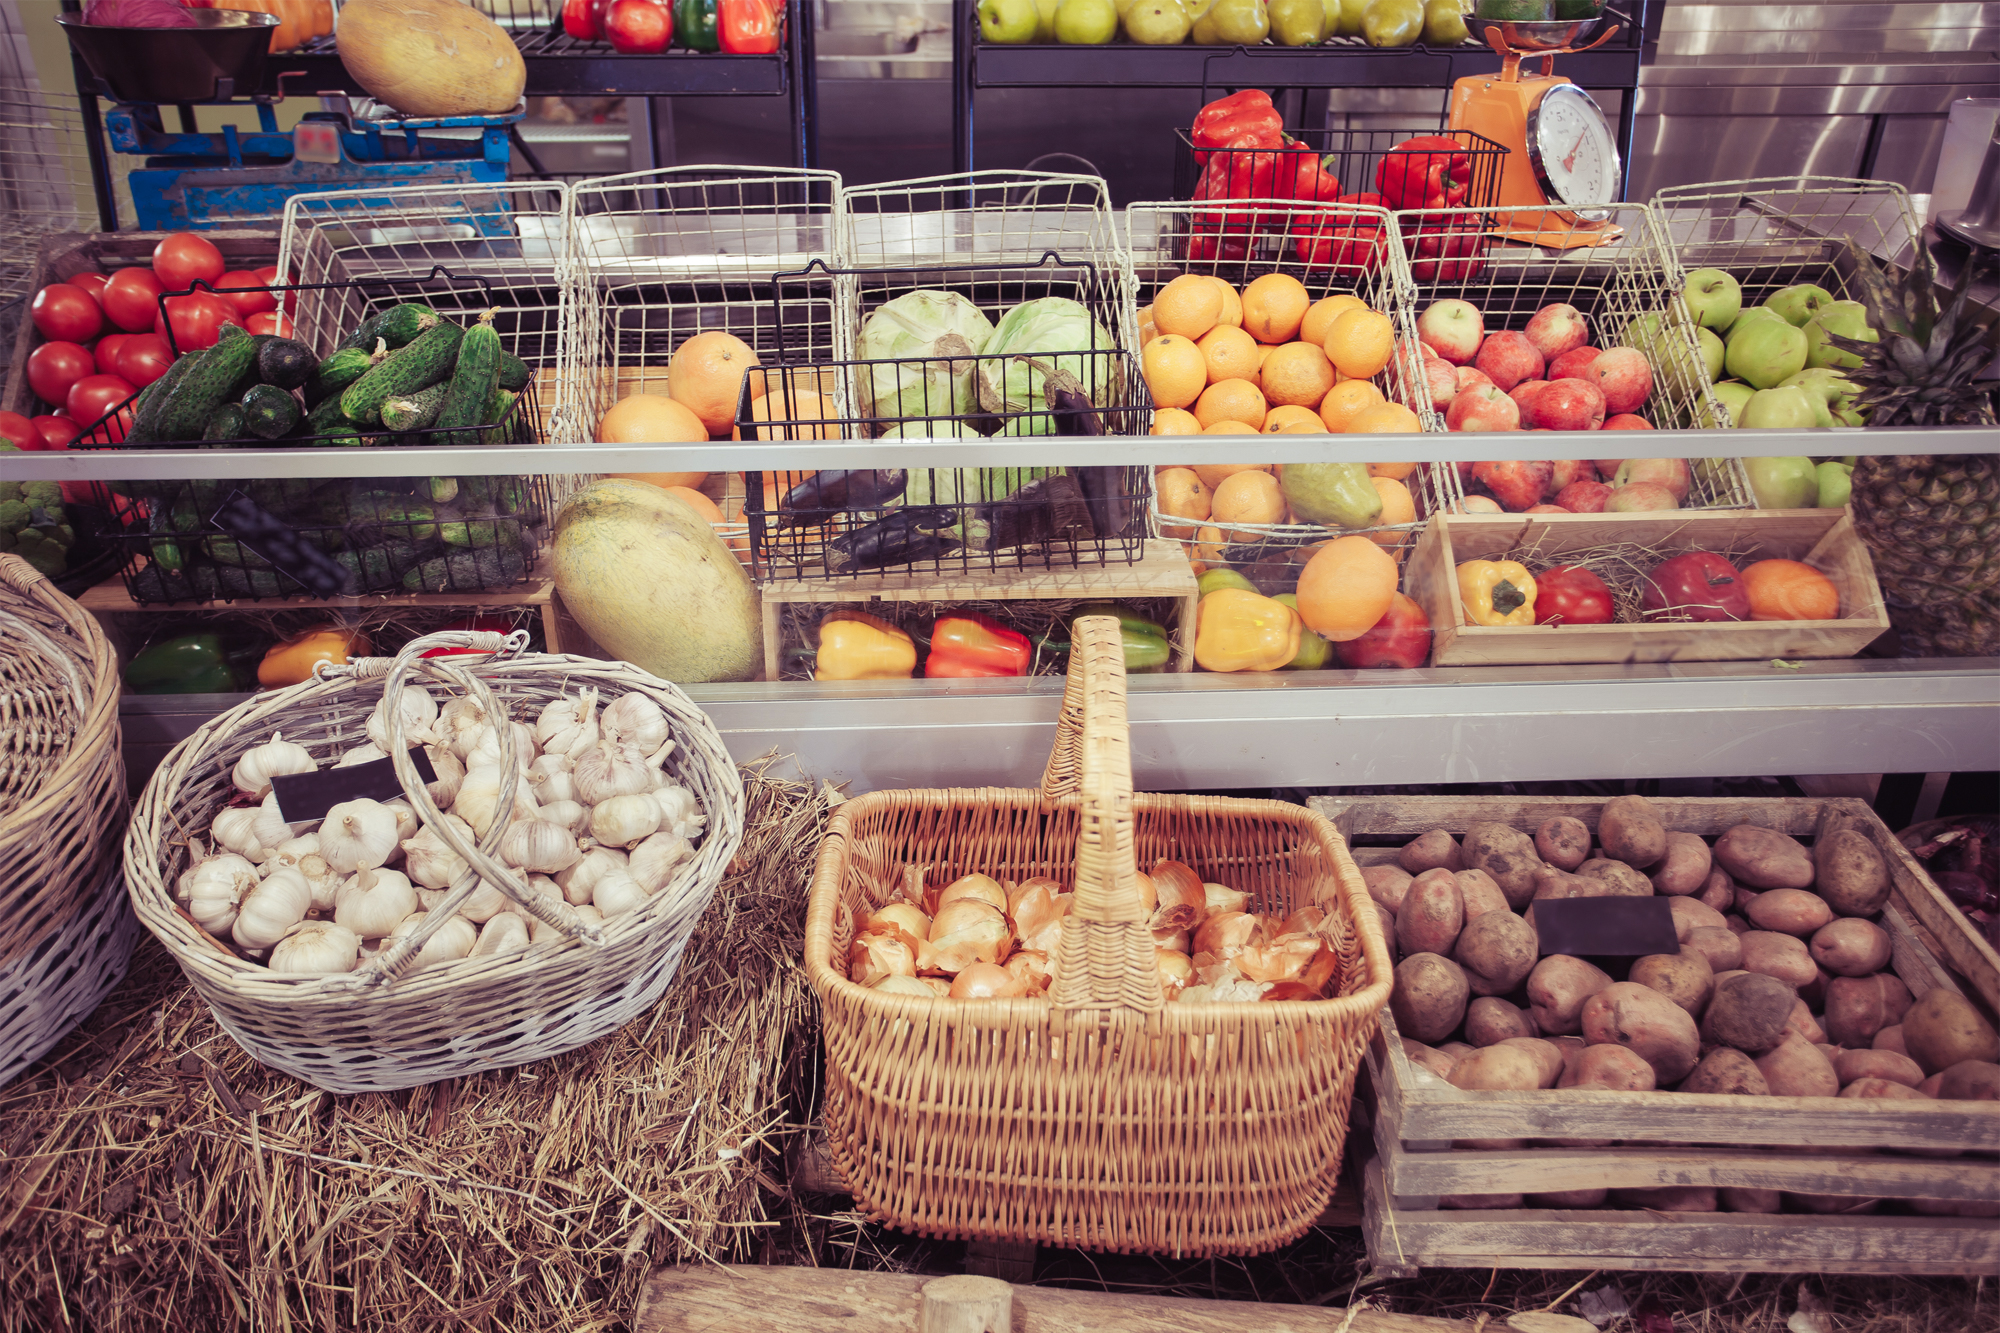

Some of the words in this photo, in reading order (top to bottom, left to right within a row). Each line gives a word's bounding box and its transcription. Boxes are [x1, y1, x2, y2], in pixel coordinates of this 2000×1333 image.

[1556, 111, 1563, 122] 5
[1563, 186, 1570, 197] 3
[1587, 181, 1594, 191] 2
